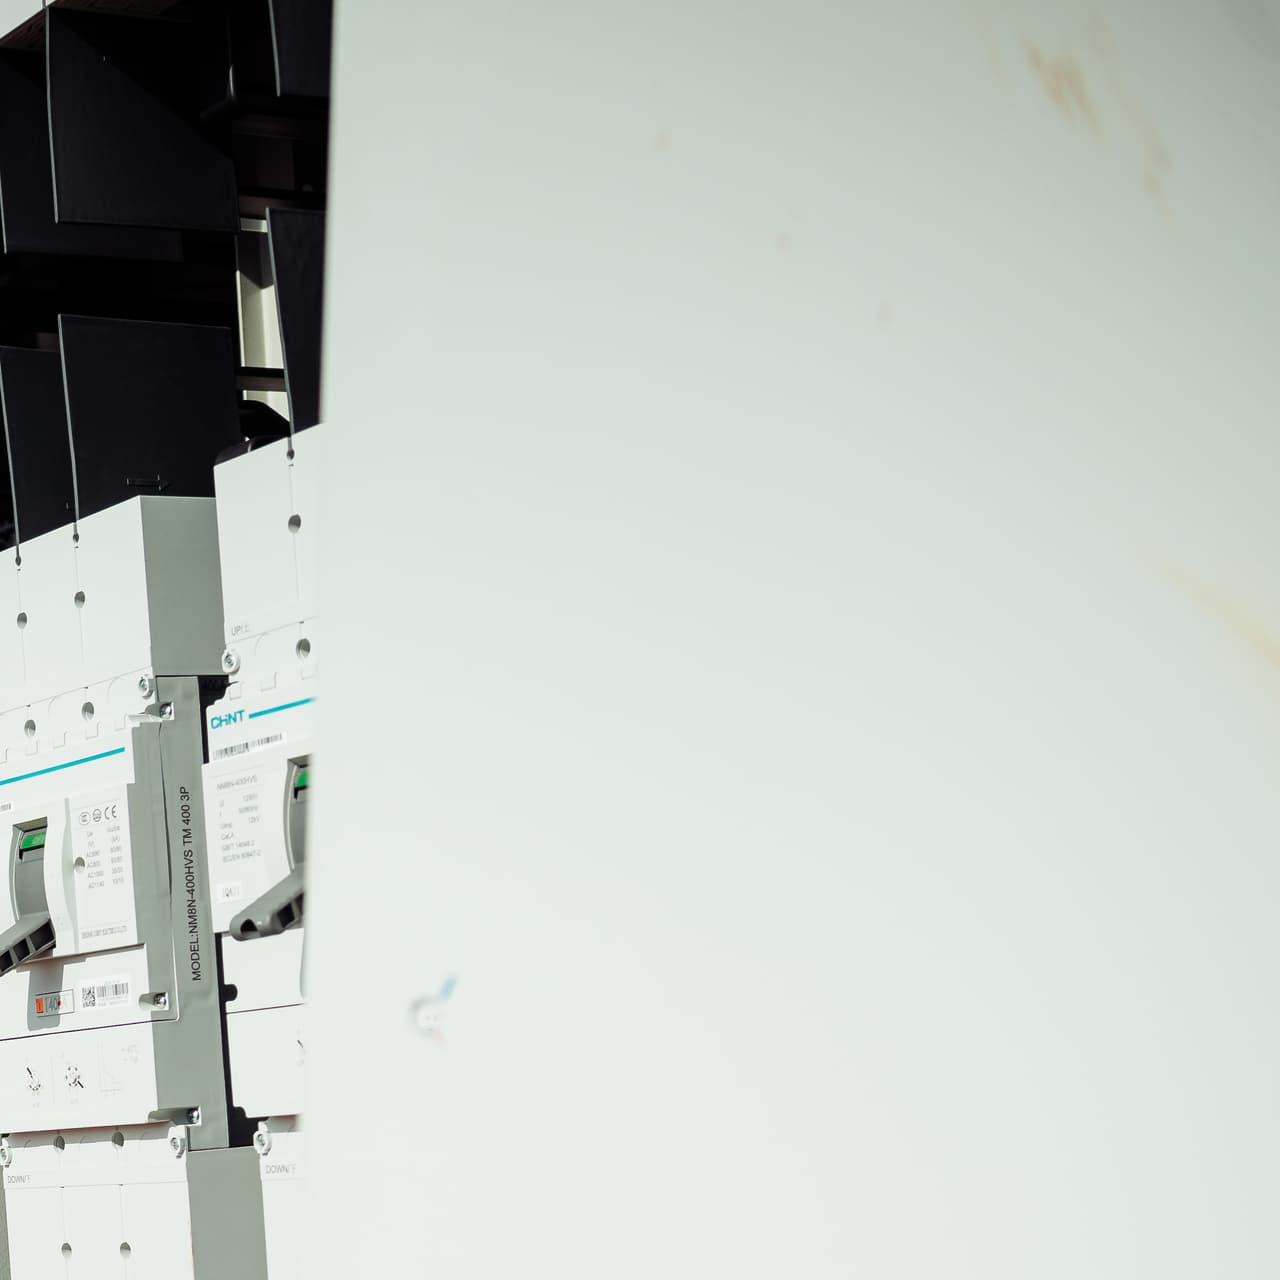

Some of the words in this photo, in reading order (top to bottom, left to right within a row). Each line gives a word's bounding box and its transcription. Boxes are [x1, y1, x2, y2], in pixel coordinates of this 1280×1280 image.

[179, 786, 190, 802] 3P
[181, 804, 191, 826] 400
[183, 827, 193, 847] TM
[184, 849, 201, 982] MODEL:NM8N-400HVS
